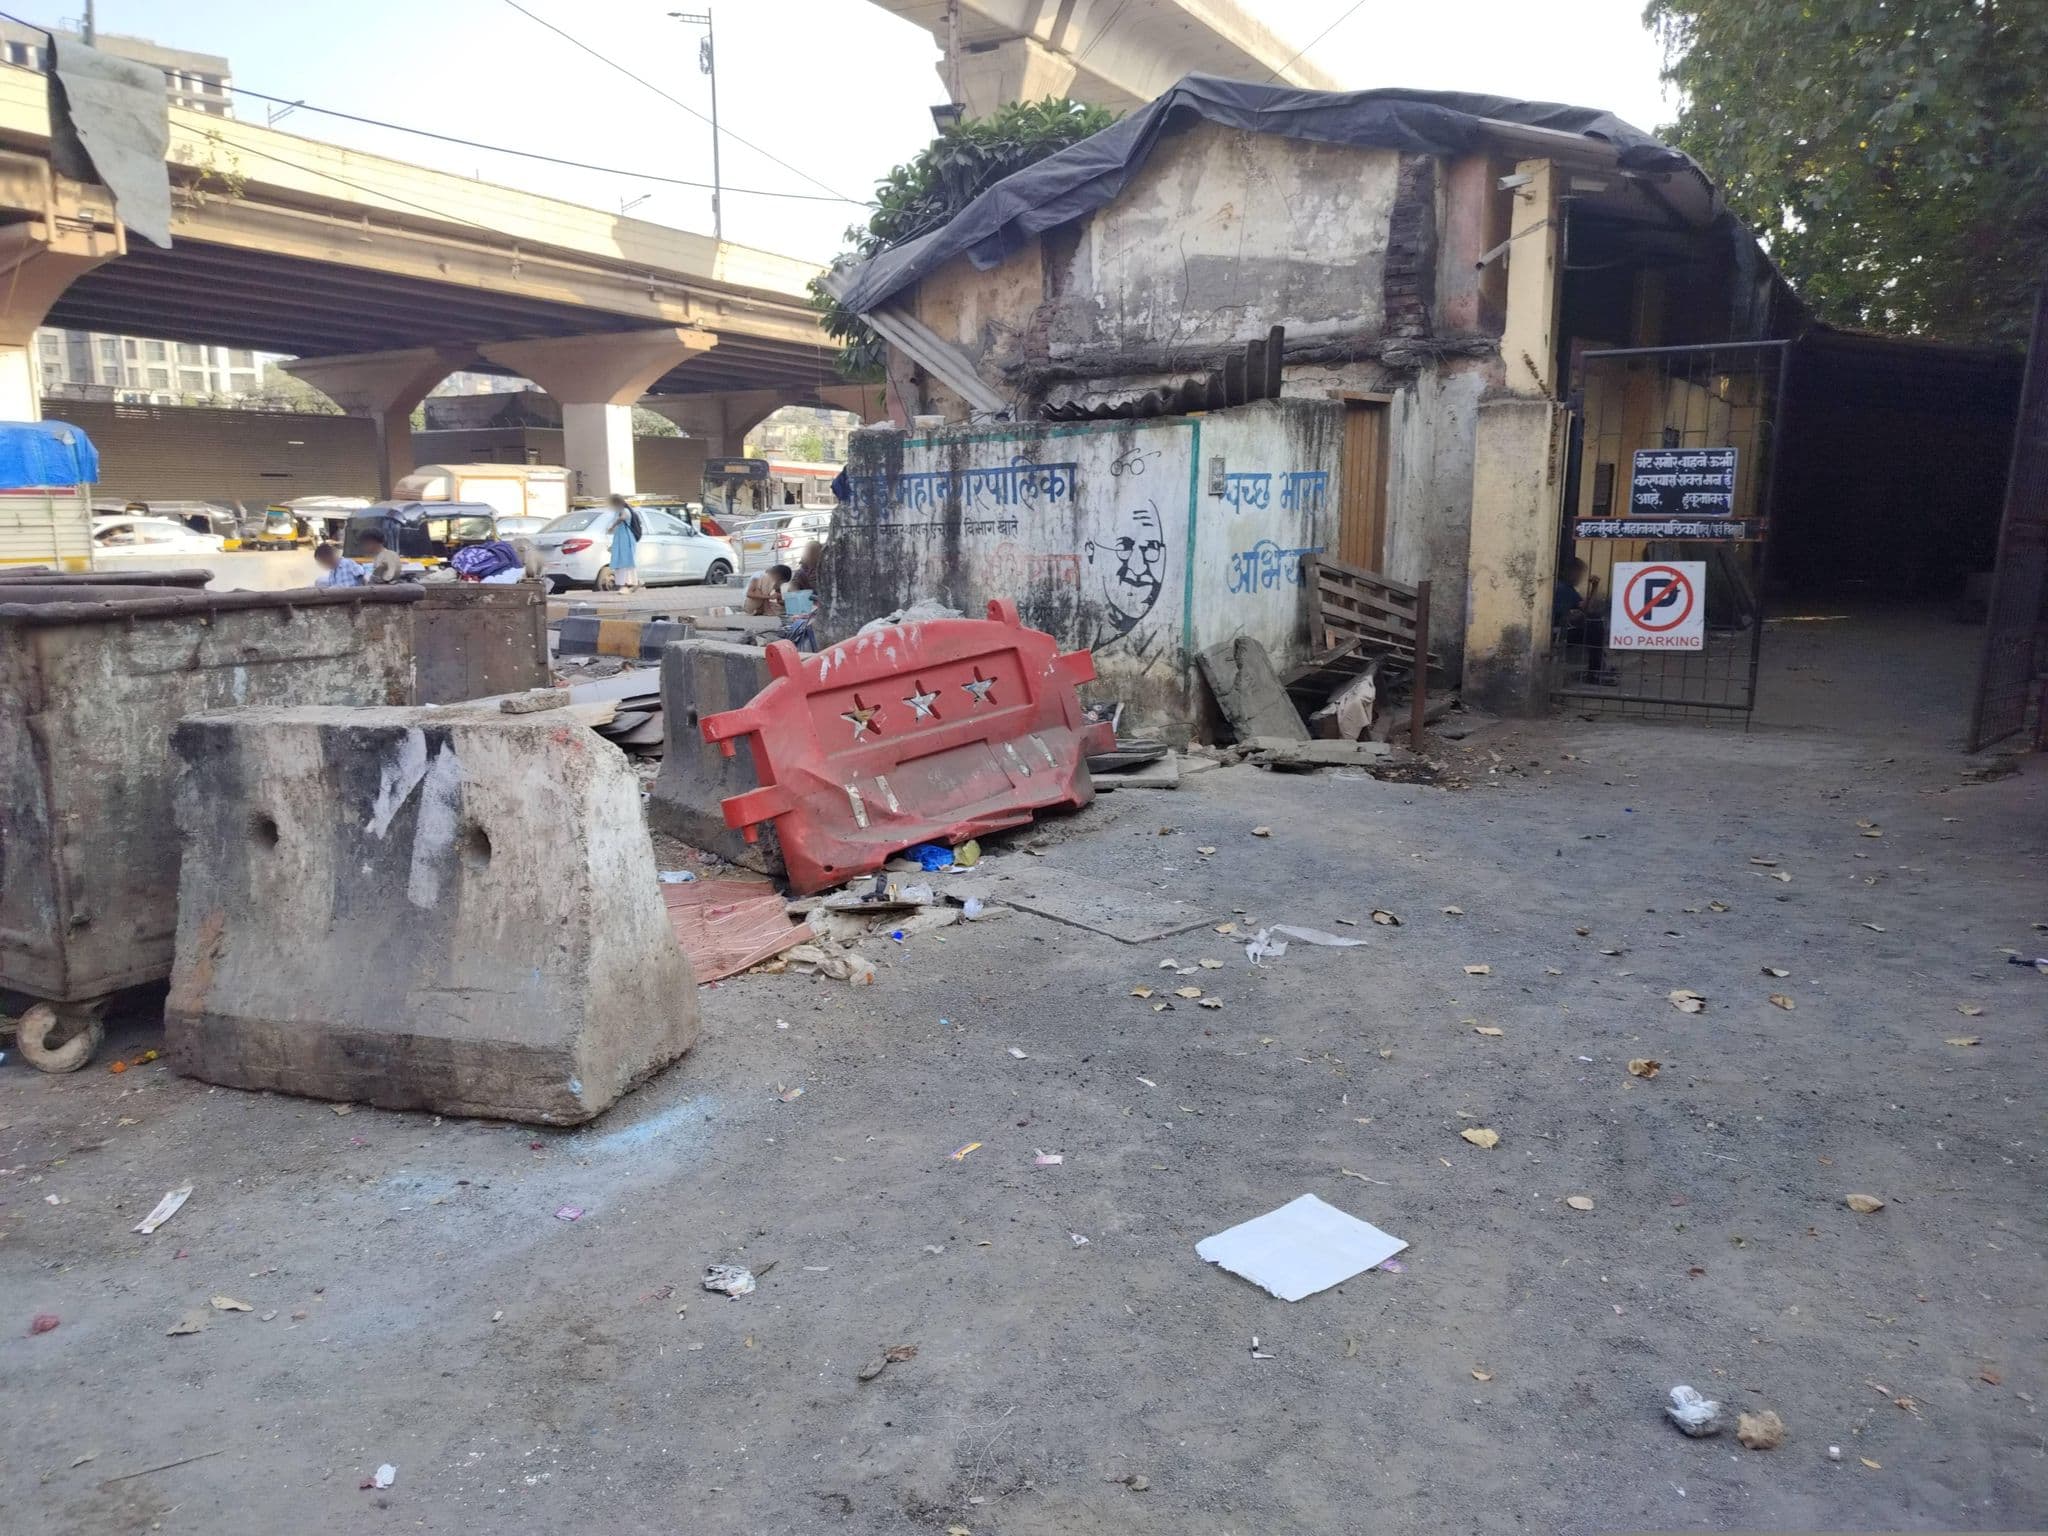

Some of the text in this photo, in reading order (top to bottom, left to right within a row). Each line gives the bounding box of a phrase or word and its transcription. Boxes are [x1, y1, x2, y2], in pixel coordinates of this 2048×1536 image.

[1279, 471, 1328, 512] भारत
[963, 516, 996, 536] विभाग
[1612, 635, 1701, 648] NO PARKING
